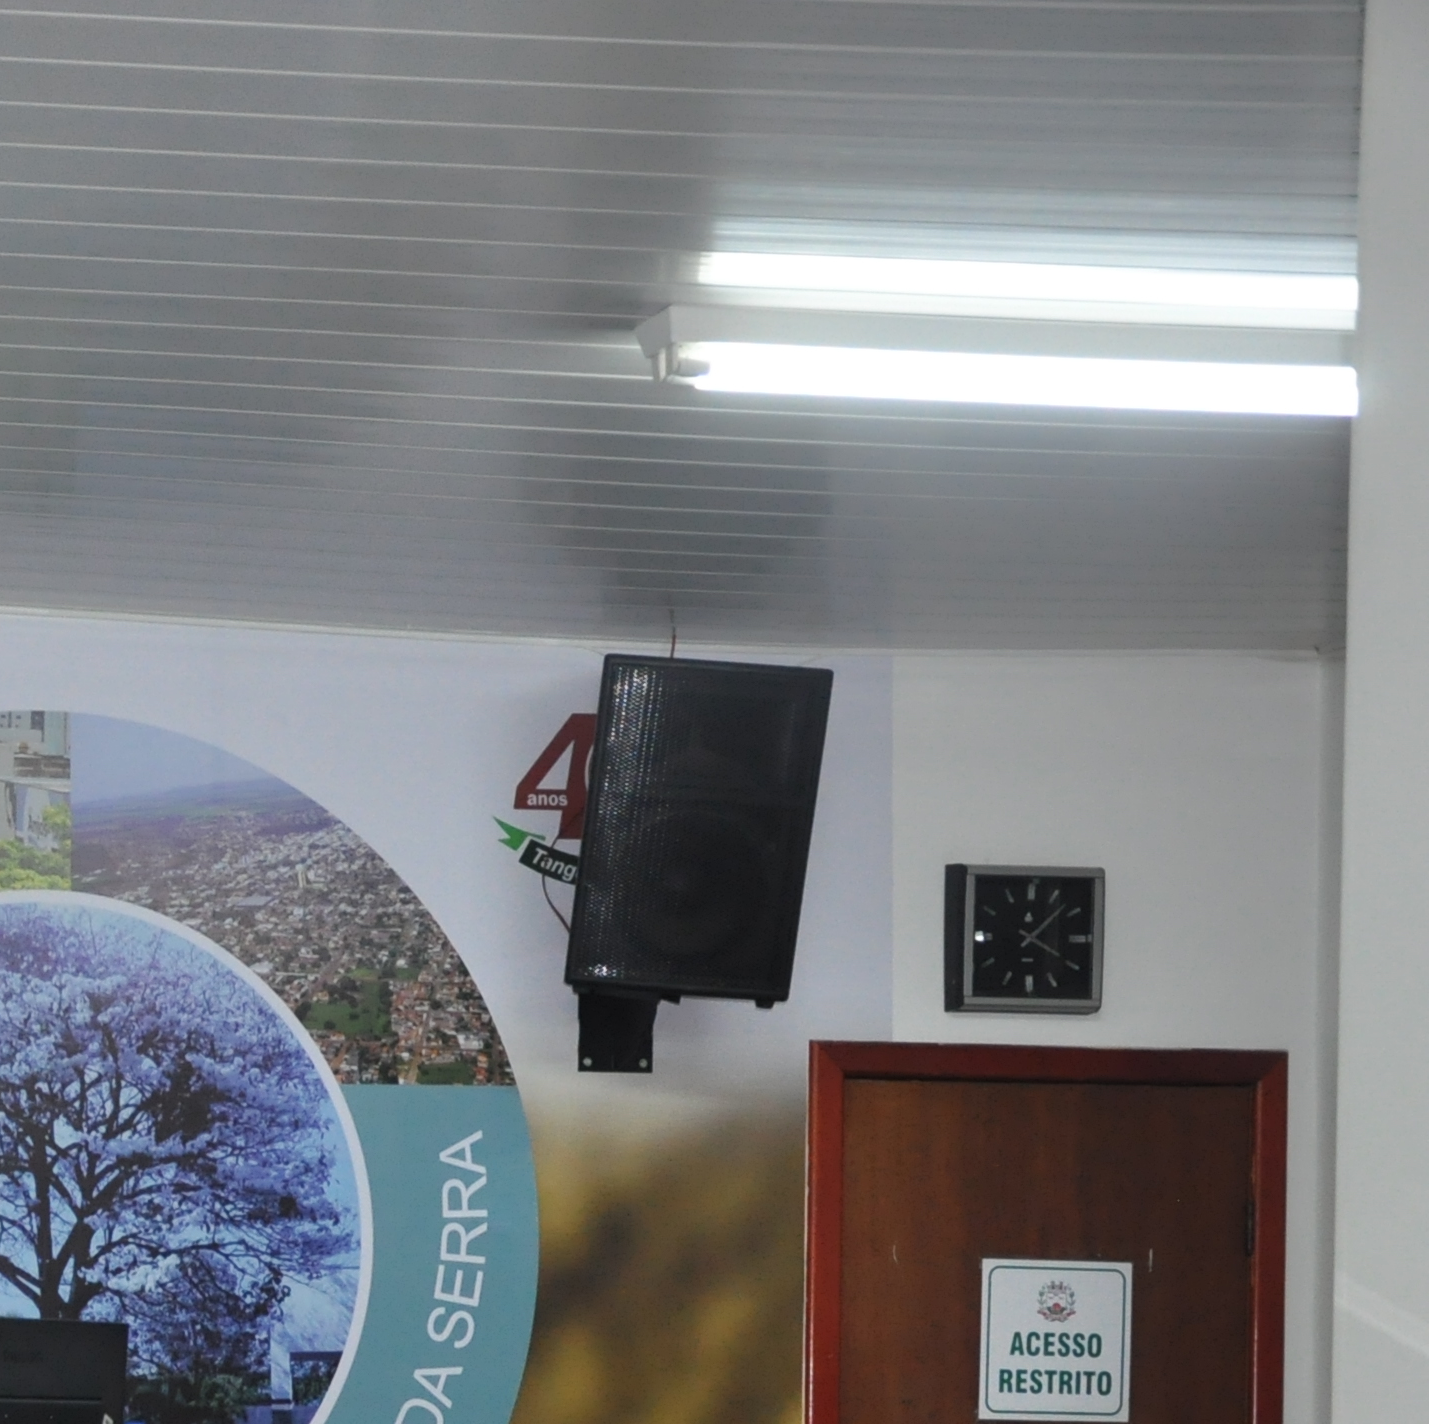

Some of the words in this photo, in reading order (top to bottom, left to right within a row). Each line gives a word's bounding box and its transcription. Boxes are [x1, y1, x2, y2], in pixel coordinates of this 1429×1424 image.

[513, 713, 598, 839] 4
[527, 794, 568, 807] anos
[530, 848, 581, 882] Tang
[425, 1130, 490, 1350] SERRA
[1009, 1331, 1103, 1359] ACESSO
[998, 1368, 1113, 1397] RESTRITO
